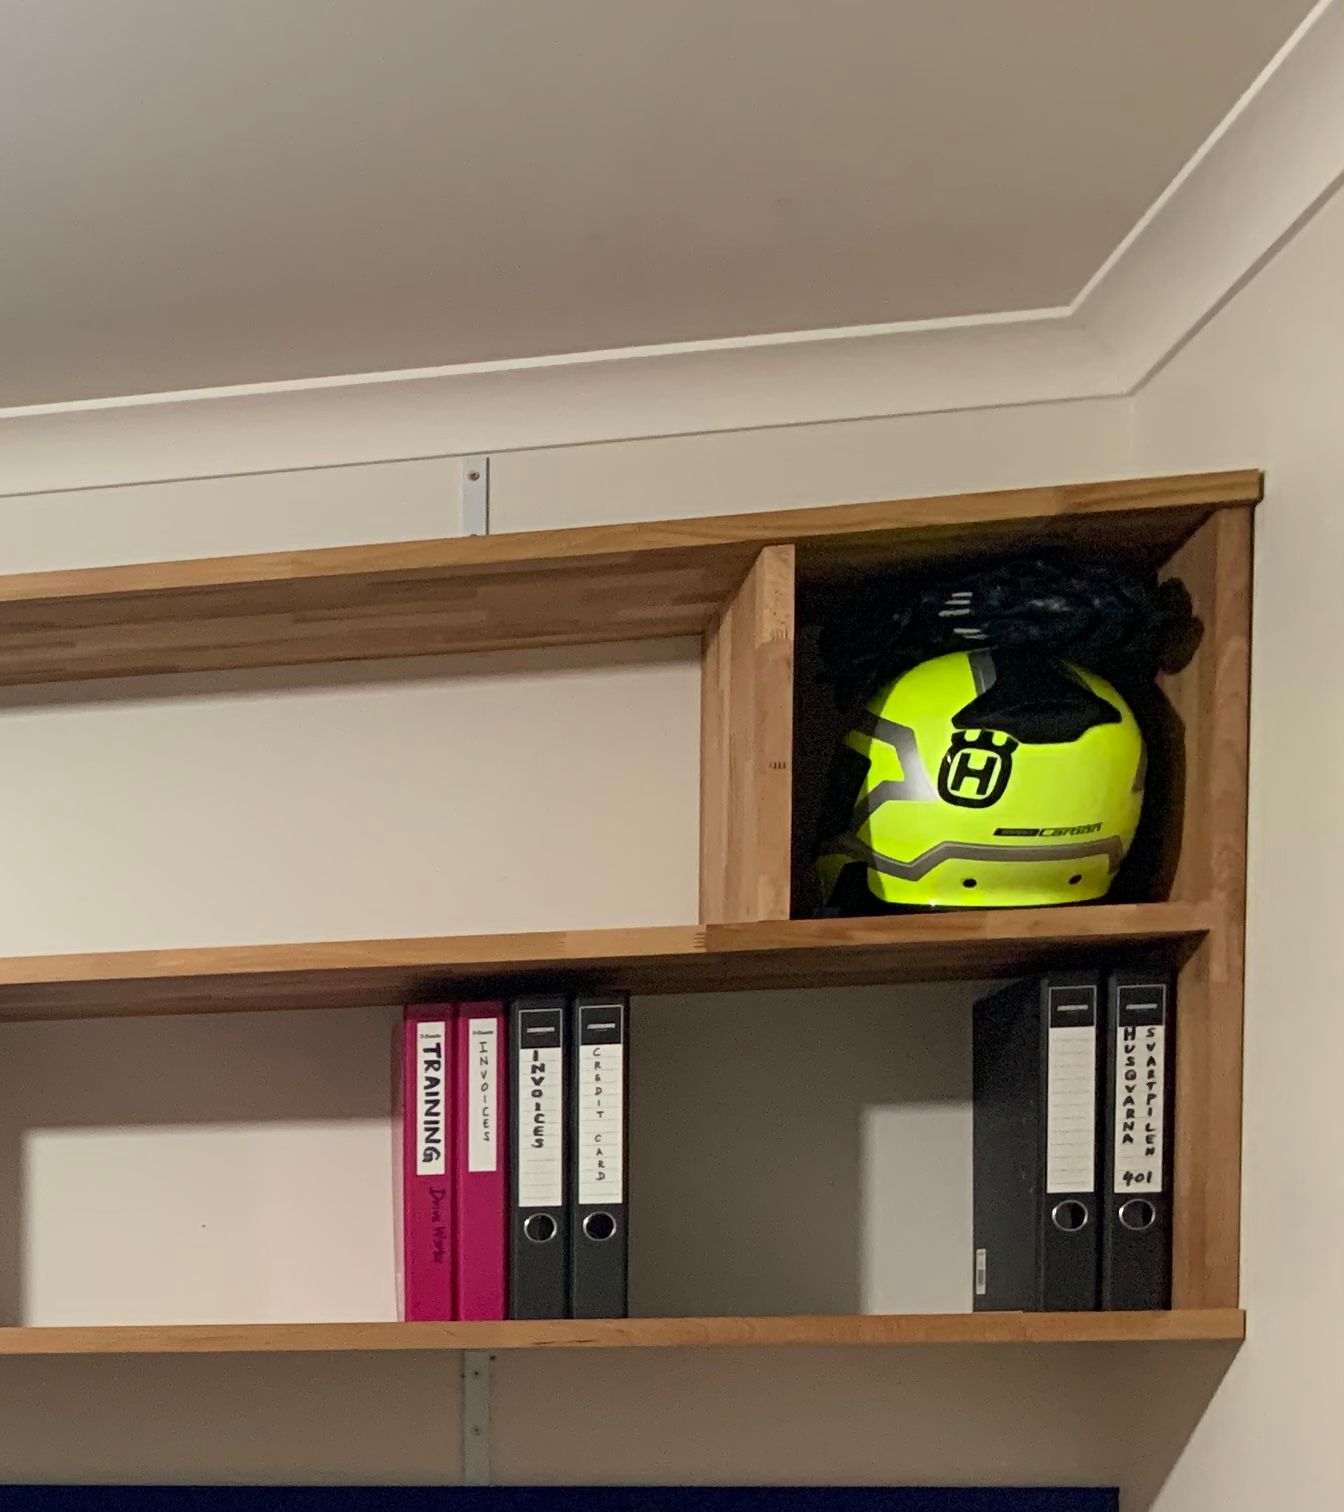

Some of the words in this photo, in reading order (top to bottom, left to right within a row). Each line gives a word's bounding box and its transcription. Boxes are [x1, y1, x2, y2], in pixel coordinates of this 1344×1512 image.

[950, 752, 997, 796] H
[421, 1042, 442, 1163] TRAINING
[479, 1041, 490, 1142] INVOICES
[530, 1050, 545, 1149] INVOICES
[592, 1047, 604, 1119] CREDIT
[1123, 1026, 1136, 1144] HUSQVARNA
[1145, 1027, 1157, 1156] SVARTPILEN
[594, 1134, 605, 1182] CARD
[1122, 1170, 1152, 1187] 401
